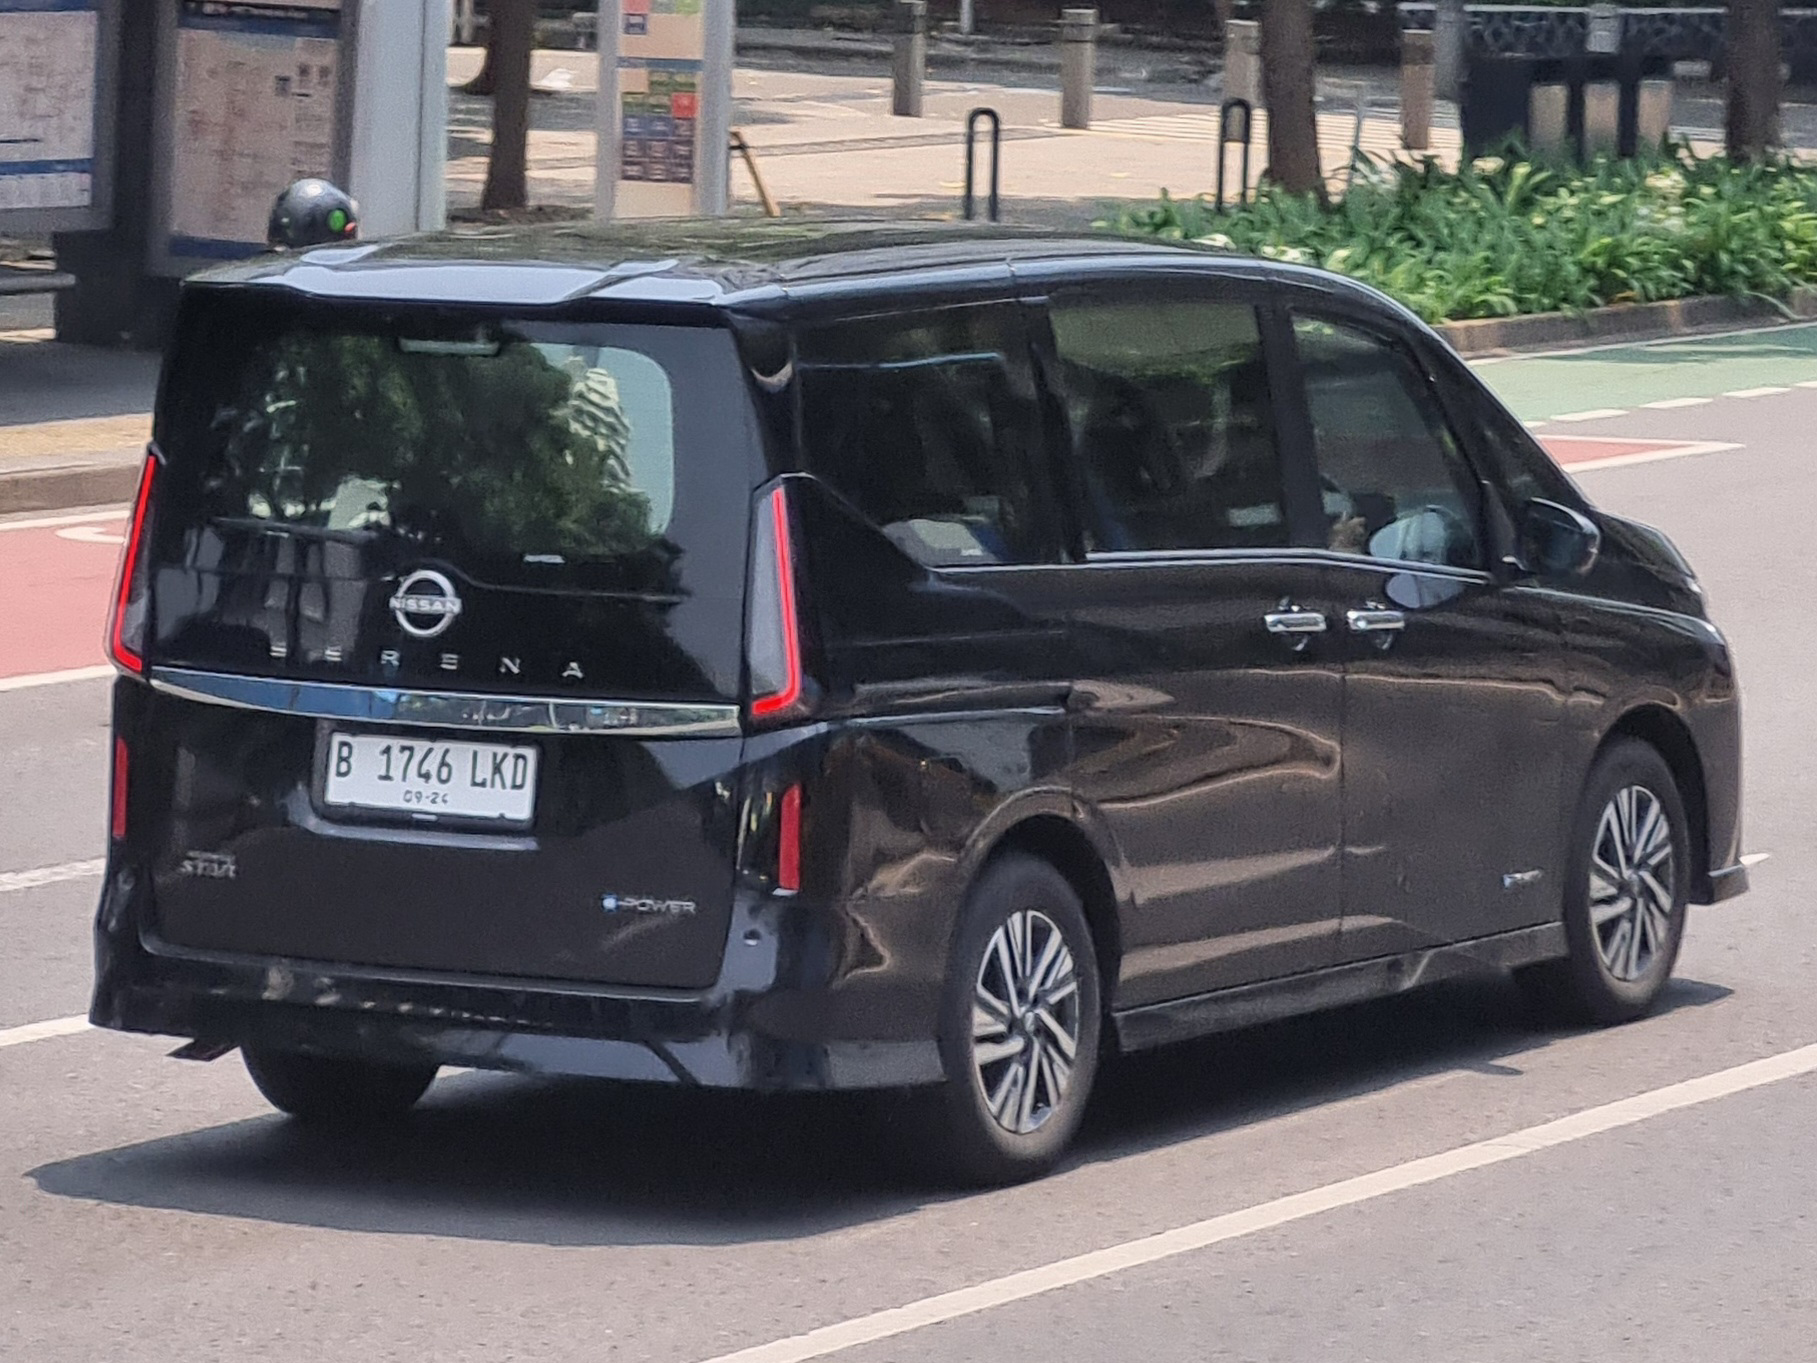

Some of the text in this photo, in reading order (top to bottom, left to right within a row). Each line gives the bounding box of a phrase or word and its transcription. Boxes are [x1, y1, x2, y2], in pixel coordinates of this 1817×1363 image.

[389, 592, 462, 613] NISSAN
[270, 642, 584, 679] SERENA
[335, 740, 528, 790] B 1746 LKD
